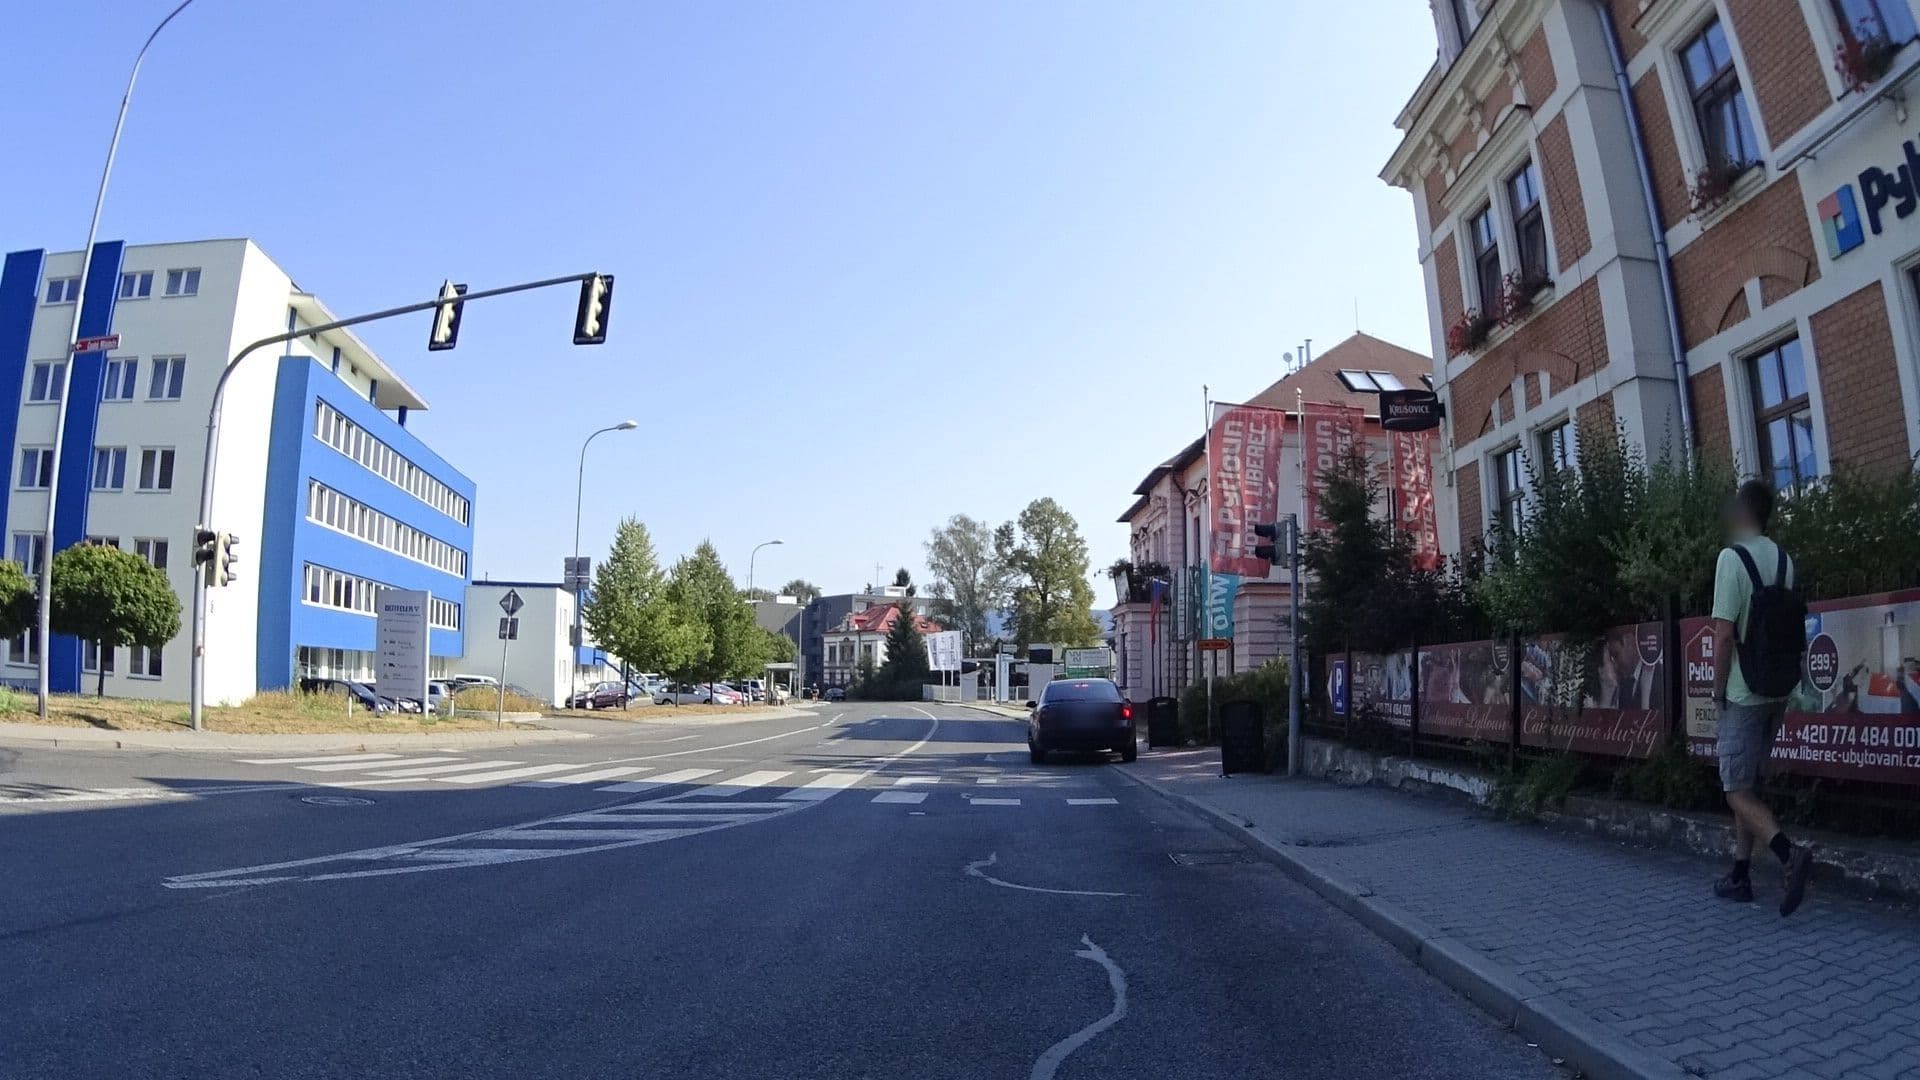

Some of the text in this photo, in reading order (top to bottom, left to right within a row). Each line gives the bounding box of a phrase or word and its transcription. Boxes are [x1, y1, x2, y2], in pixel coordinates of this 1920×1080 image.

[1217, 420, 1244, 525] Pytloun
[1244, 422, 1267, 497] LIBEREC
[1796, 724, 1828, 744] +420
[1832, 725, 1857, 745] 774
[1860, 726, 1889, 747] 484
